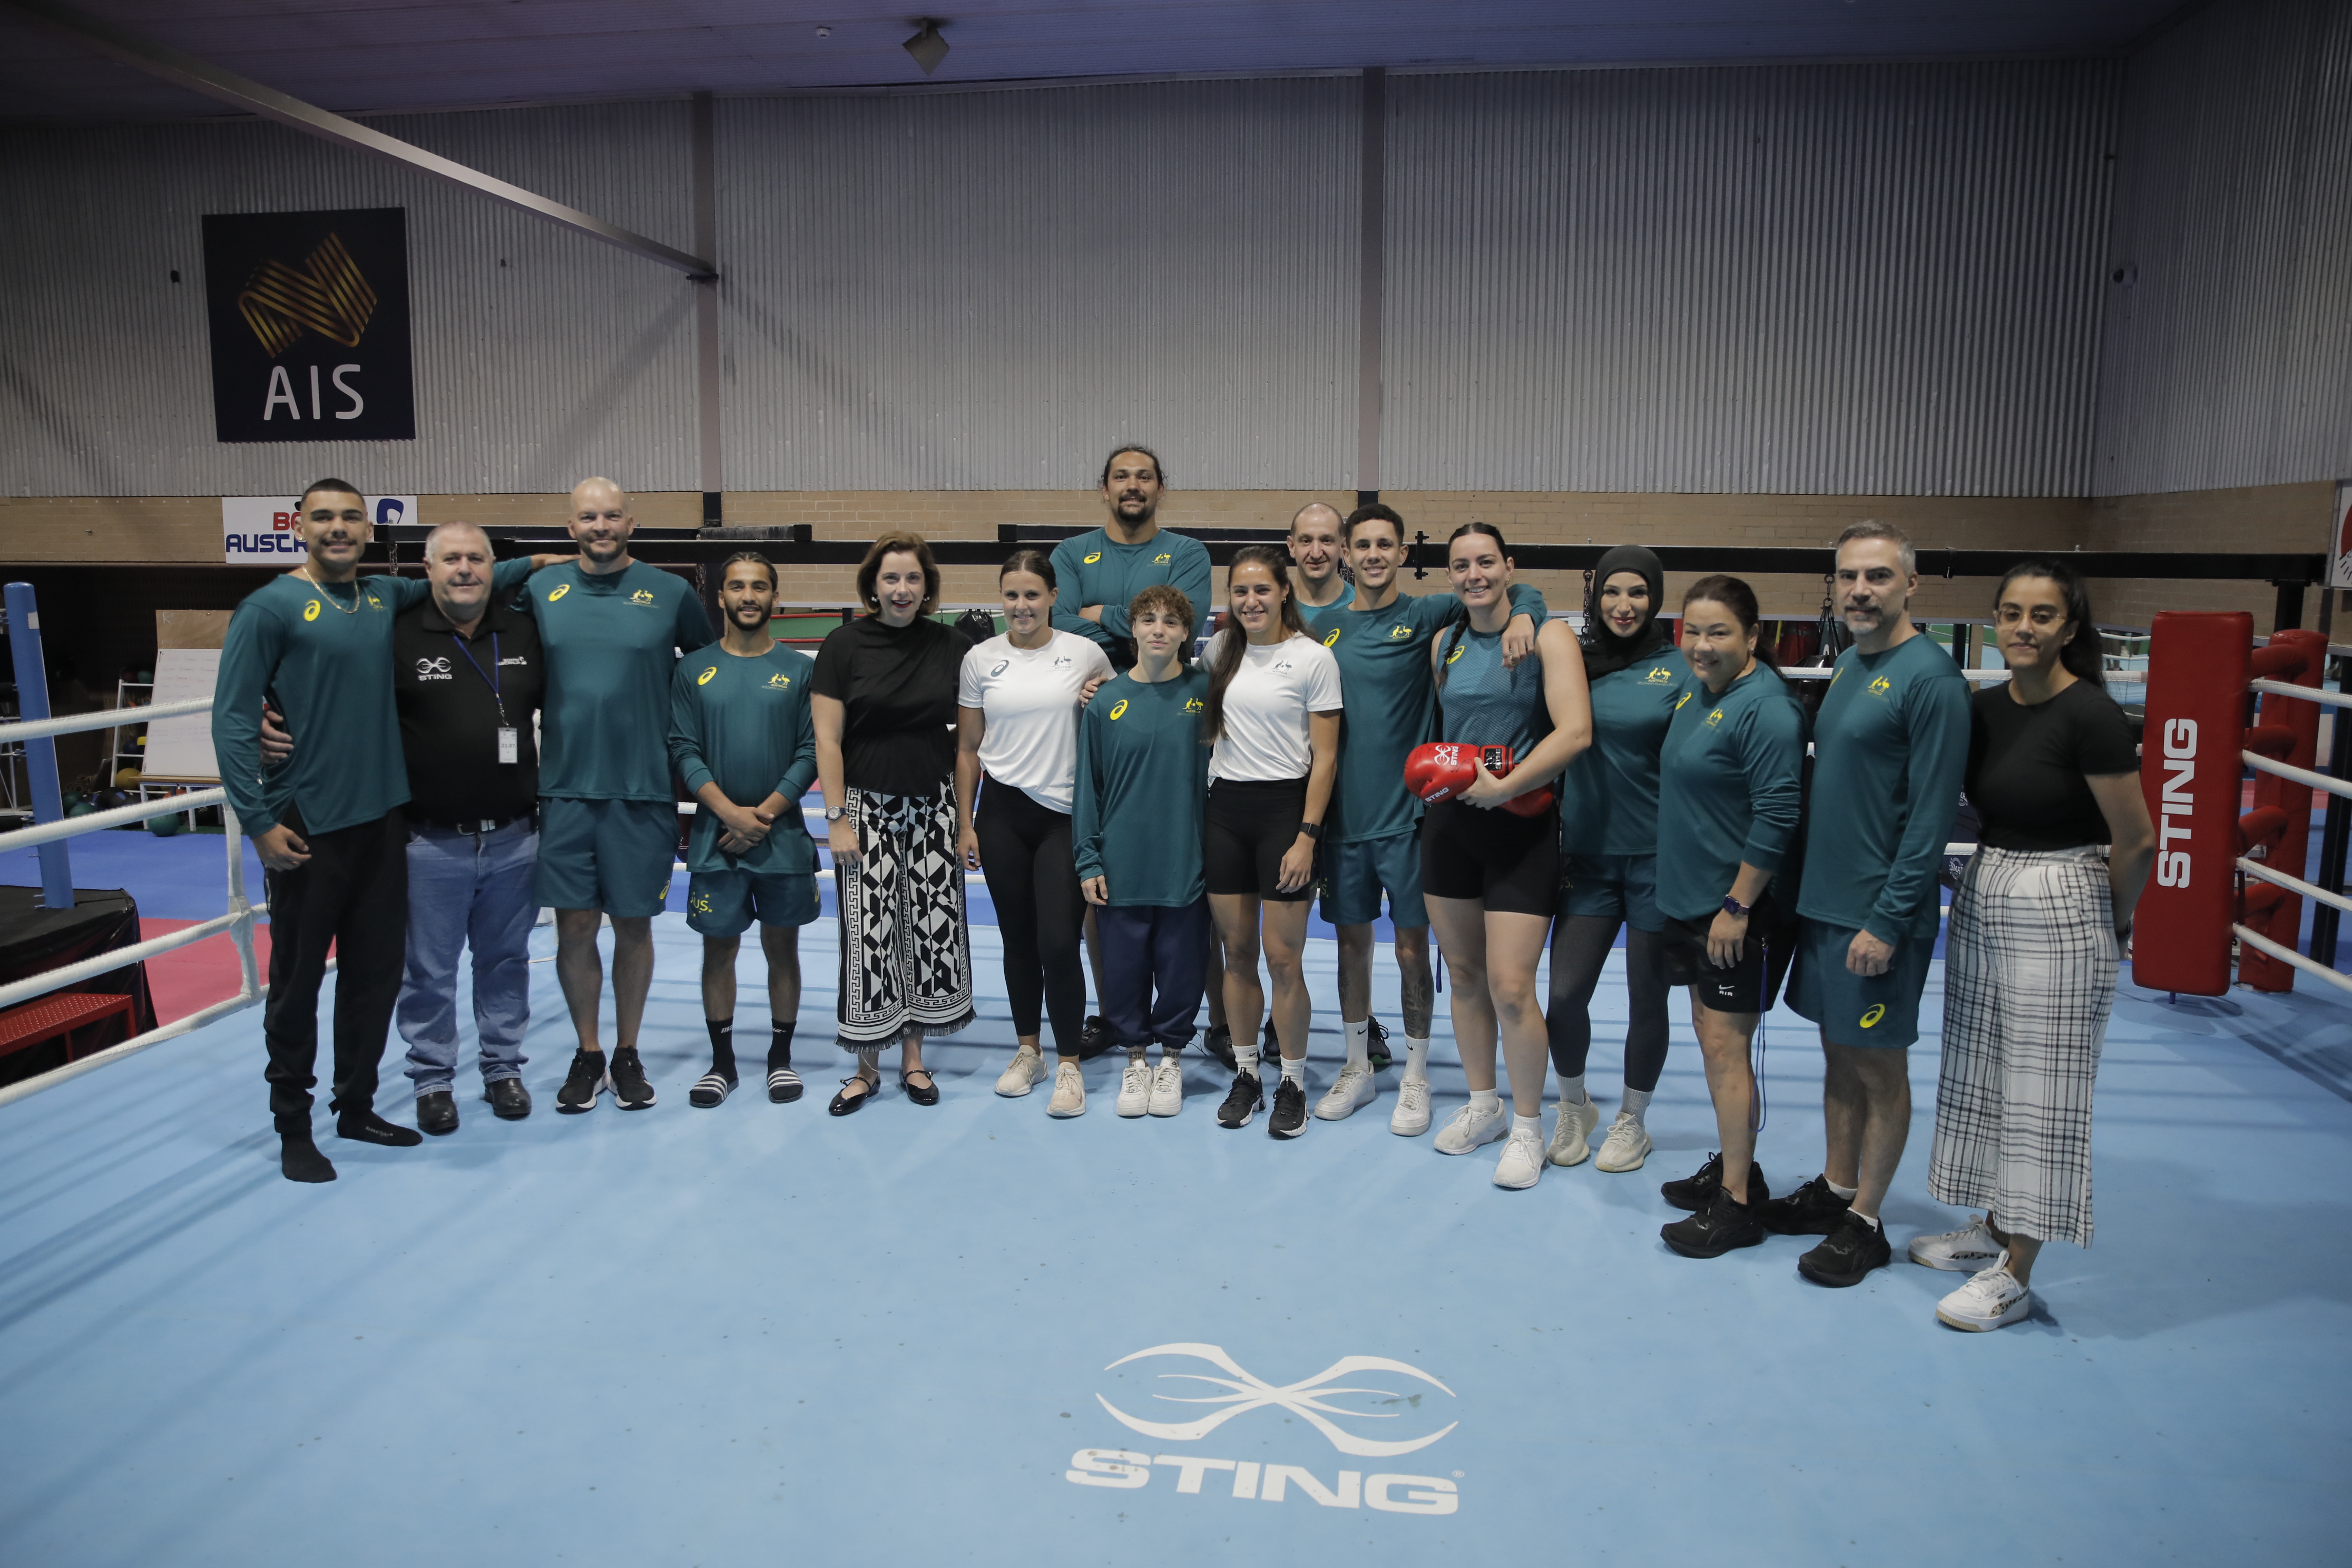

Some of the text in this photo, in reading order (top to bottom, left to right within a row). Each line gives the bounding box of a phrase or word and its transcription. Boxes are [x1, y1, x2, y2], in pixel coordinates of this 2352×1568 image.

[263, 364, 364, 420] AIS
[1451, 745, 1459, 766] STING
[1425, 787, 1449, 802] STING
[2157, 718, 2198, 888] STING
[1065, 1447, 1458, 1515] STING
